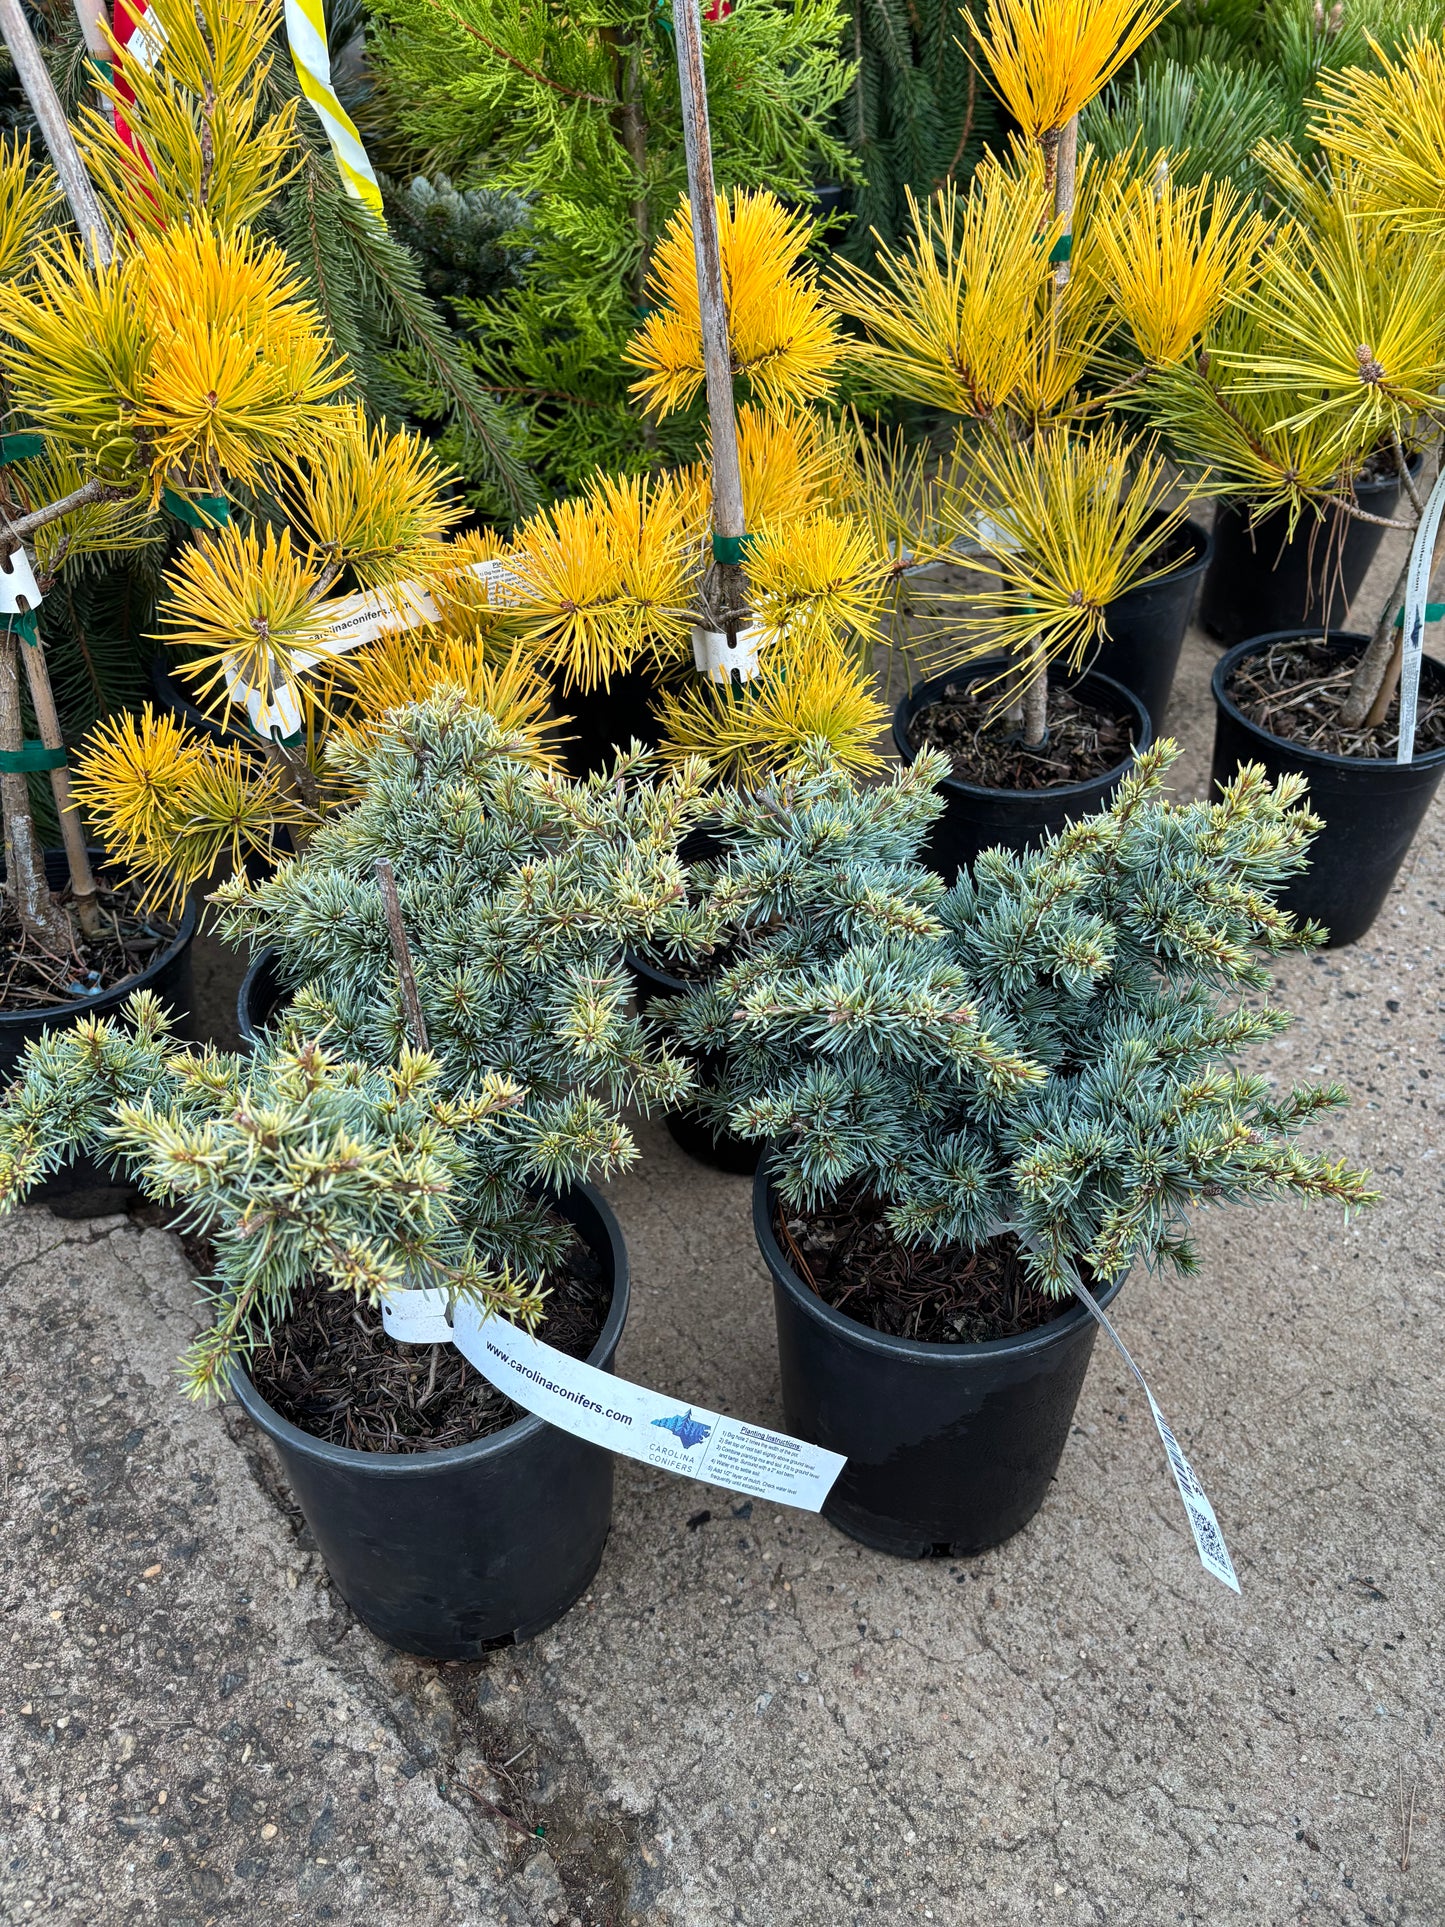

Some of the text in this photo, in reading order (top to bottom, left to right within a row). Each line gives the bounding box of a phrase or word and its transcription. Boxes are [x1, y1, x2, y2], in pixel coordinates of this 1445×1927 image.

[485, 1340, 634, 1426] www.carolinaconifers.com
[740, 1426, 802, 1451] Planting Instructions:
[648, 1442, 696, 1464] CAROLINA
[721, 1446, 741, 1456] Combine
[648, 1452, 693, 1474] CONIFERS
